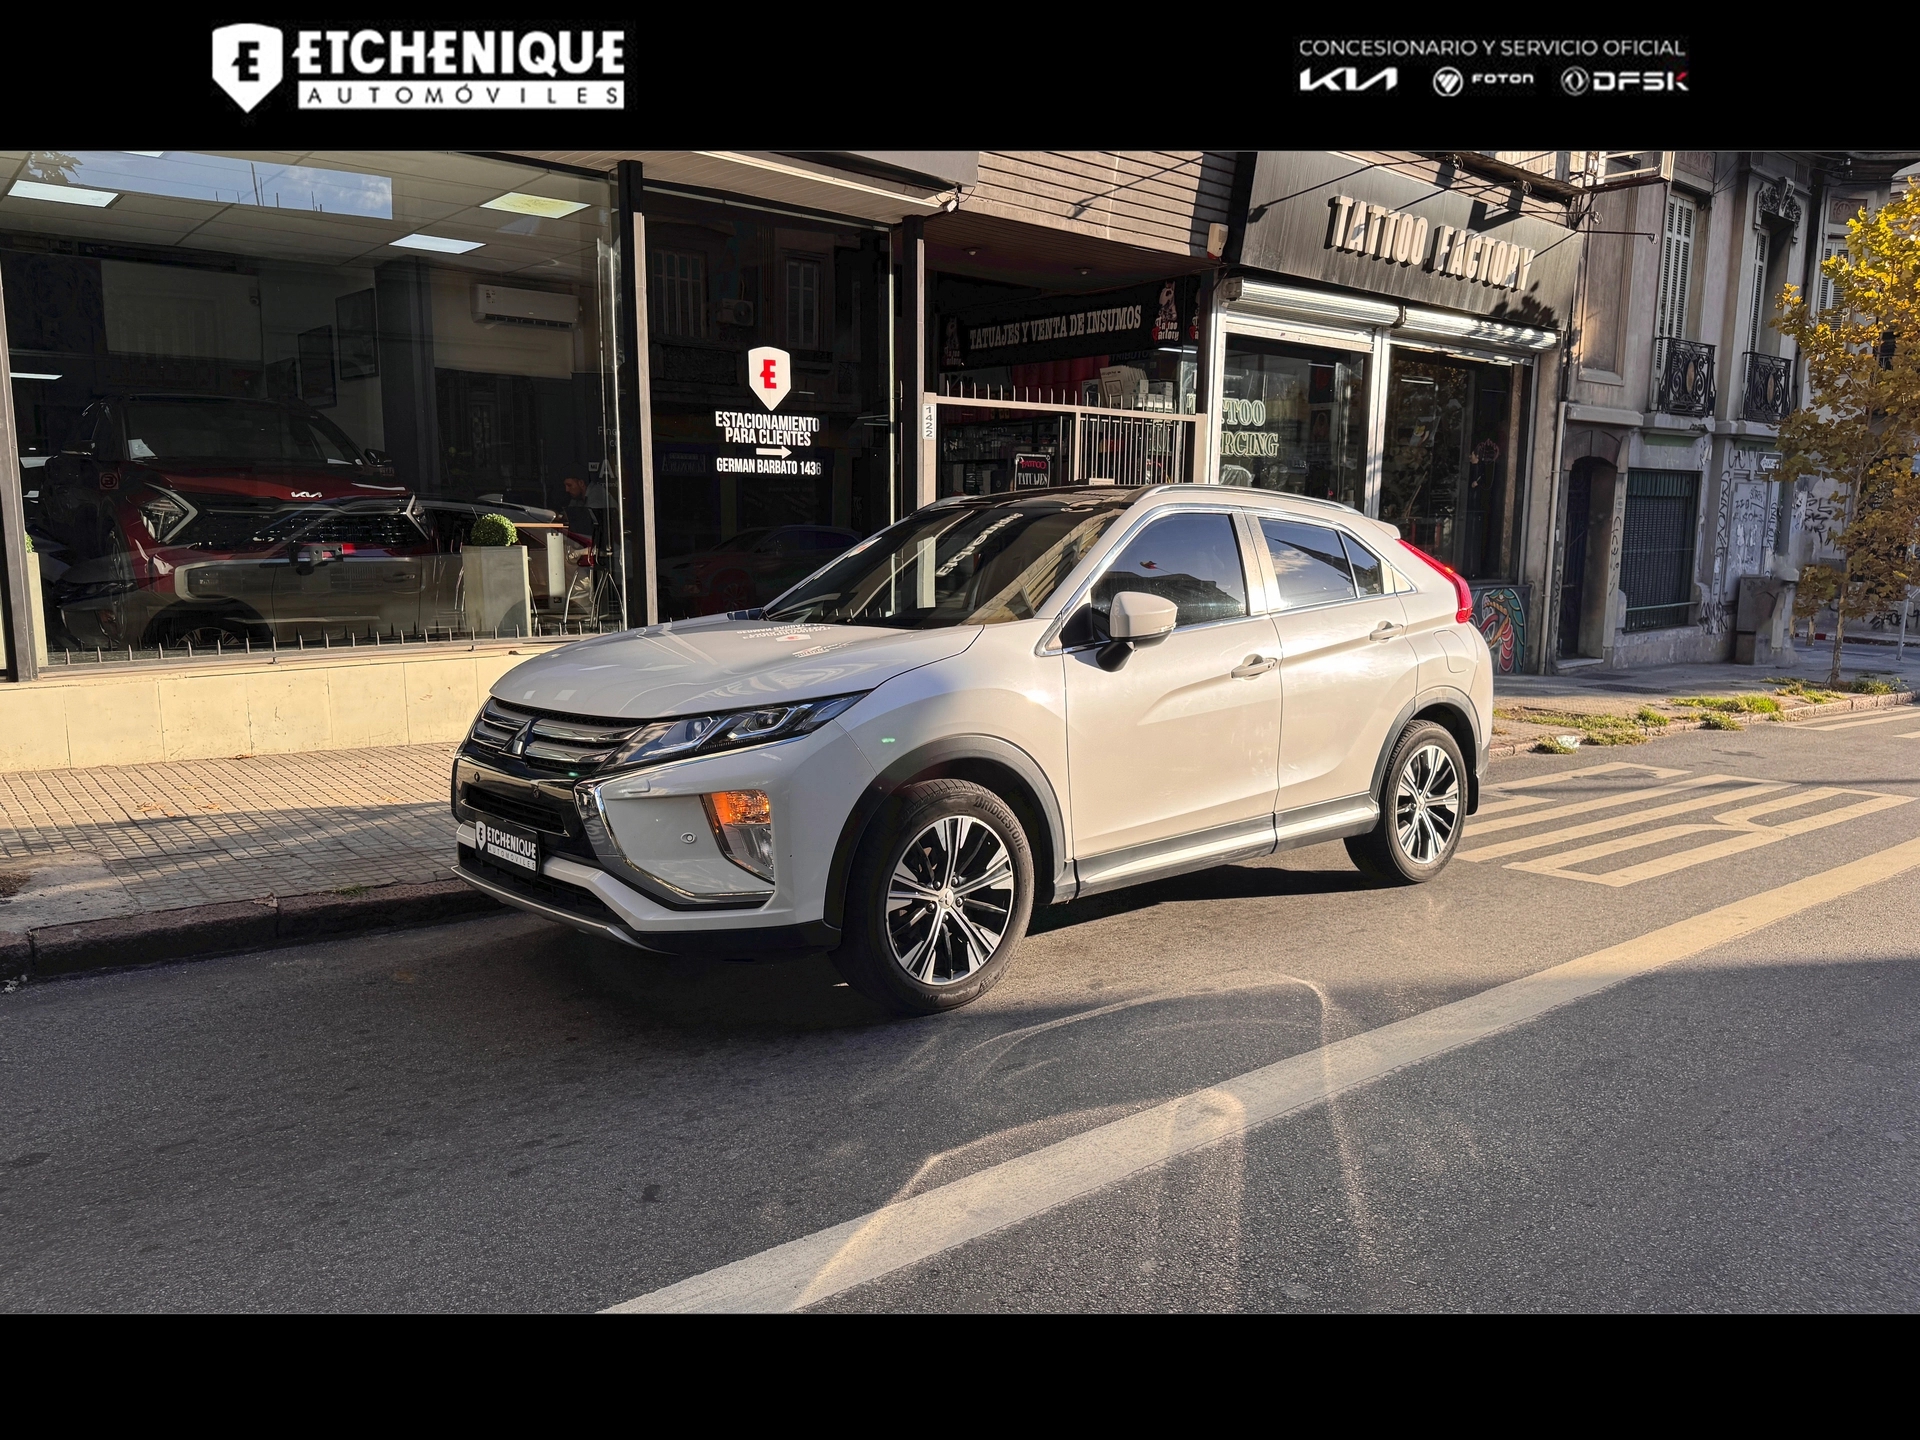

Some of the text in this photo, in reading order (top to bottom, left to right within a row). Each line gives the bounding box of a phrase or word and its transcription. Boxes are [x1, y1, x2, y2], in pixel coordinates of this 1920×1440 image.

[1333, 195, 1536, 291] TATTOO FACTORY
[970, 304, 1142, 350] TATUAJES Y VENTA DE INSUMOS
[715, 411, 820, 432] ESTACIONAMIENTO
[924, 405, 934, 438] 1422
[1222, 398, 1266, 426] TOO
[725, 427, 812, 446] PARA CLIENTES
[1220, 431, 1279, 457] RCING
[716, 457, 756, 473] GERMAN
[757, 459, 798, 475] BARBATO
[800, 461, 822, 476] 1436
[973, 796, 1027, 854] BRIDGESTONE
[486, 826, 537, 859] ETCHENIQUE
